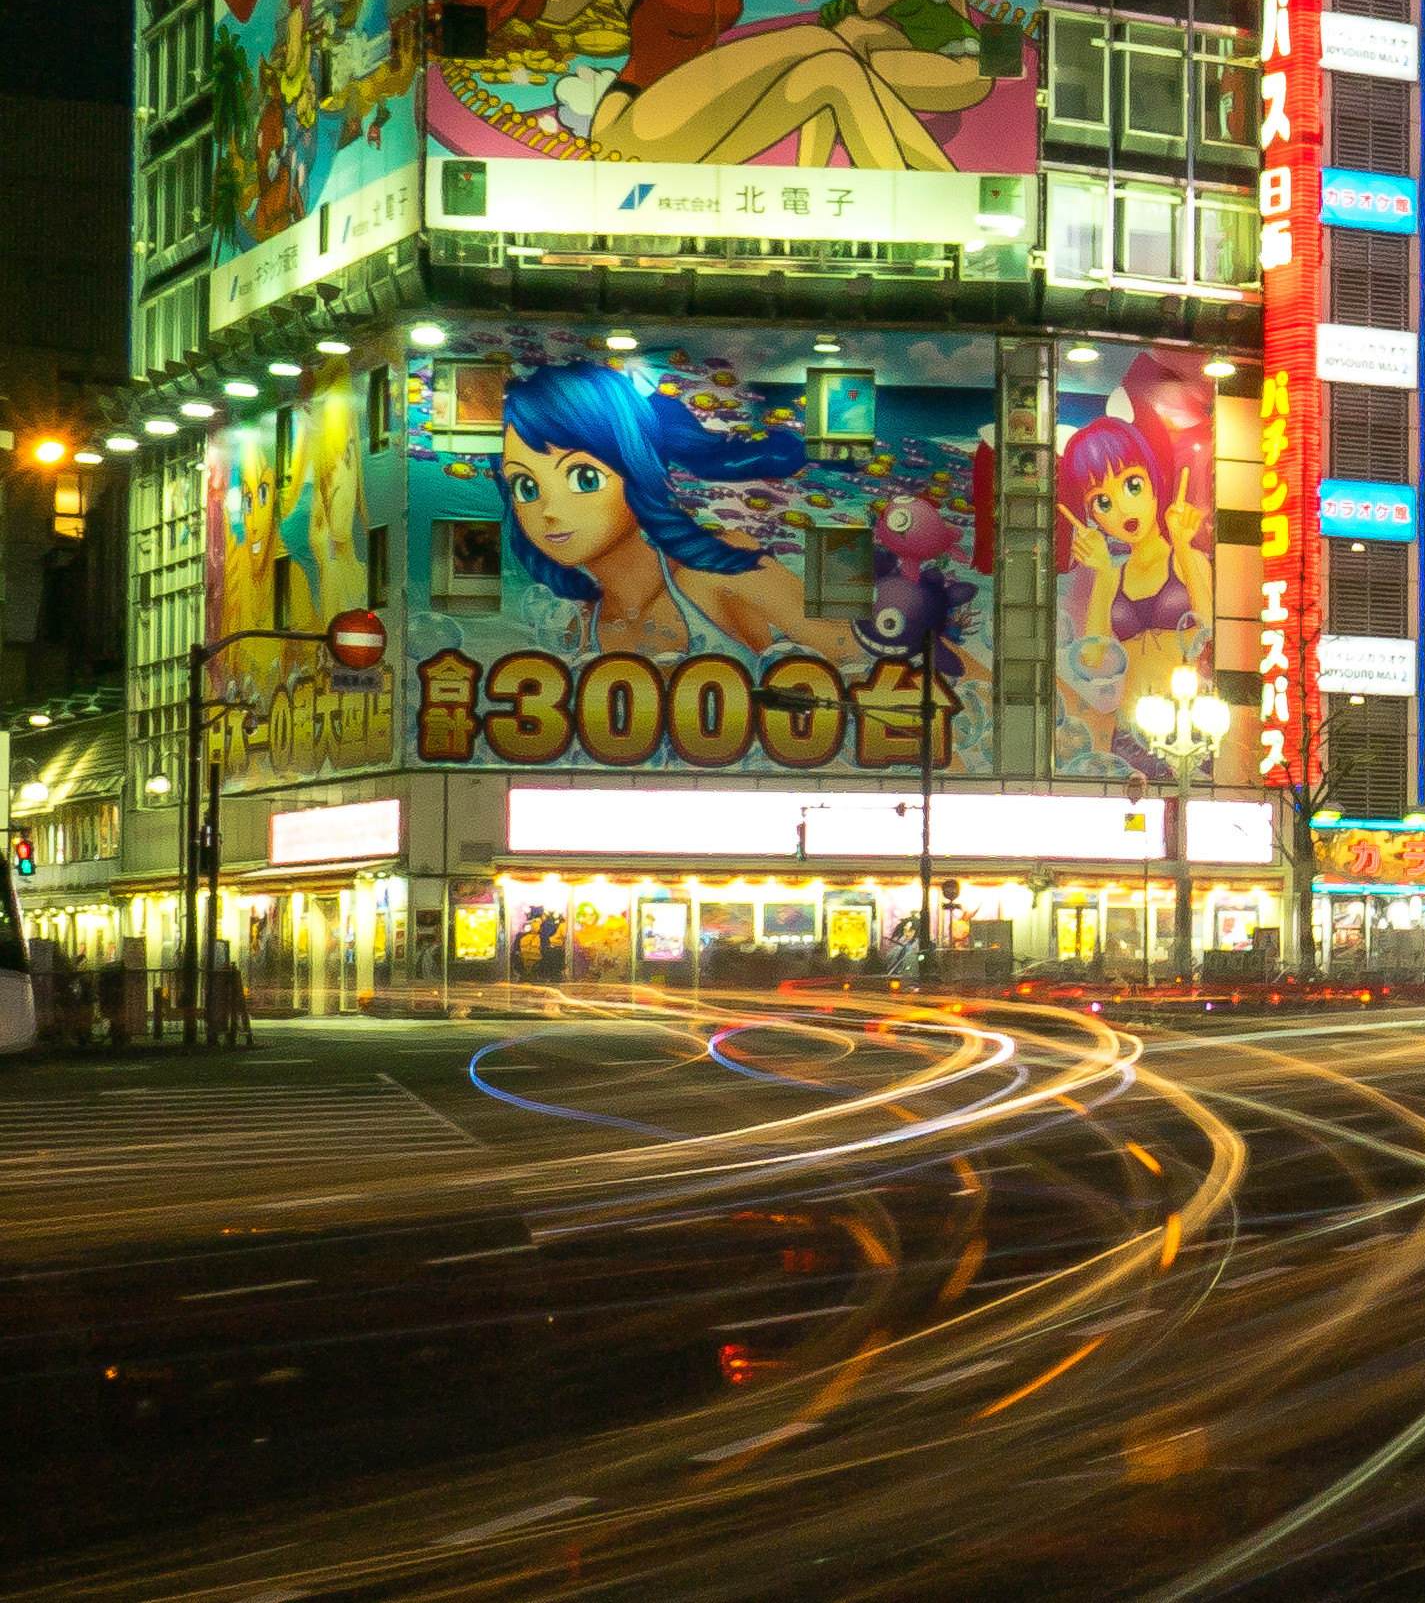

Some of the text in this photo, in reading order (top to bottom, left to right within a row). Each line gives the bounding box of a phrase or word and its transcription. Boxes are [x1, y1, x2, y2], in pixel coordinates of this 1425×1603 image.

[736, 185, 855, 218] 北電子
[1260, 370, 1290, 558] パチンコ
[1259, 581, 1290, 775] エスパス
